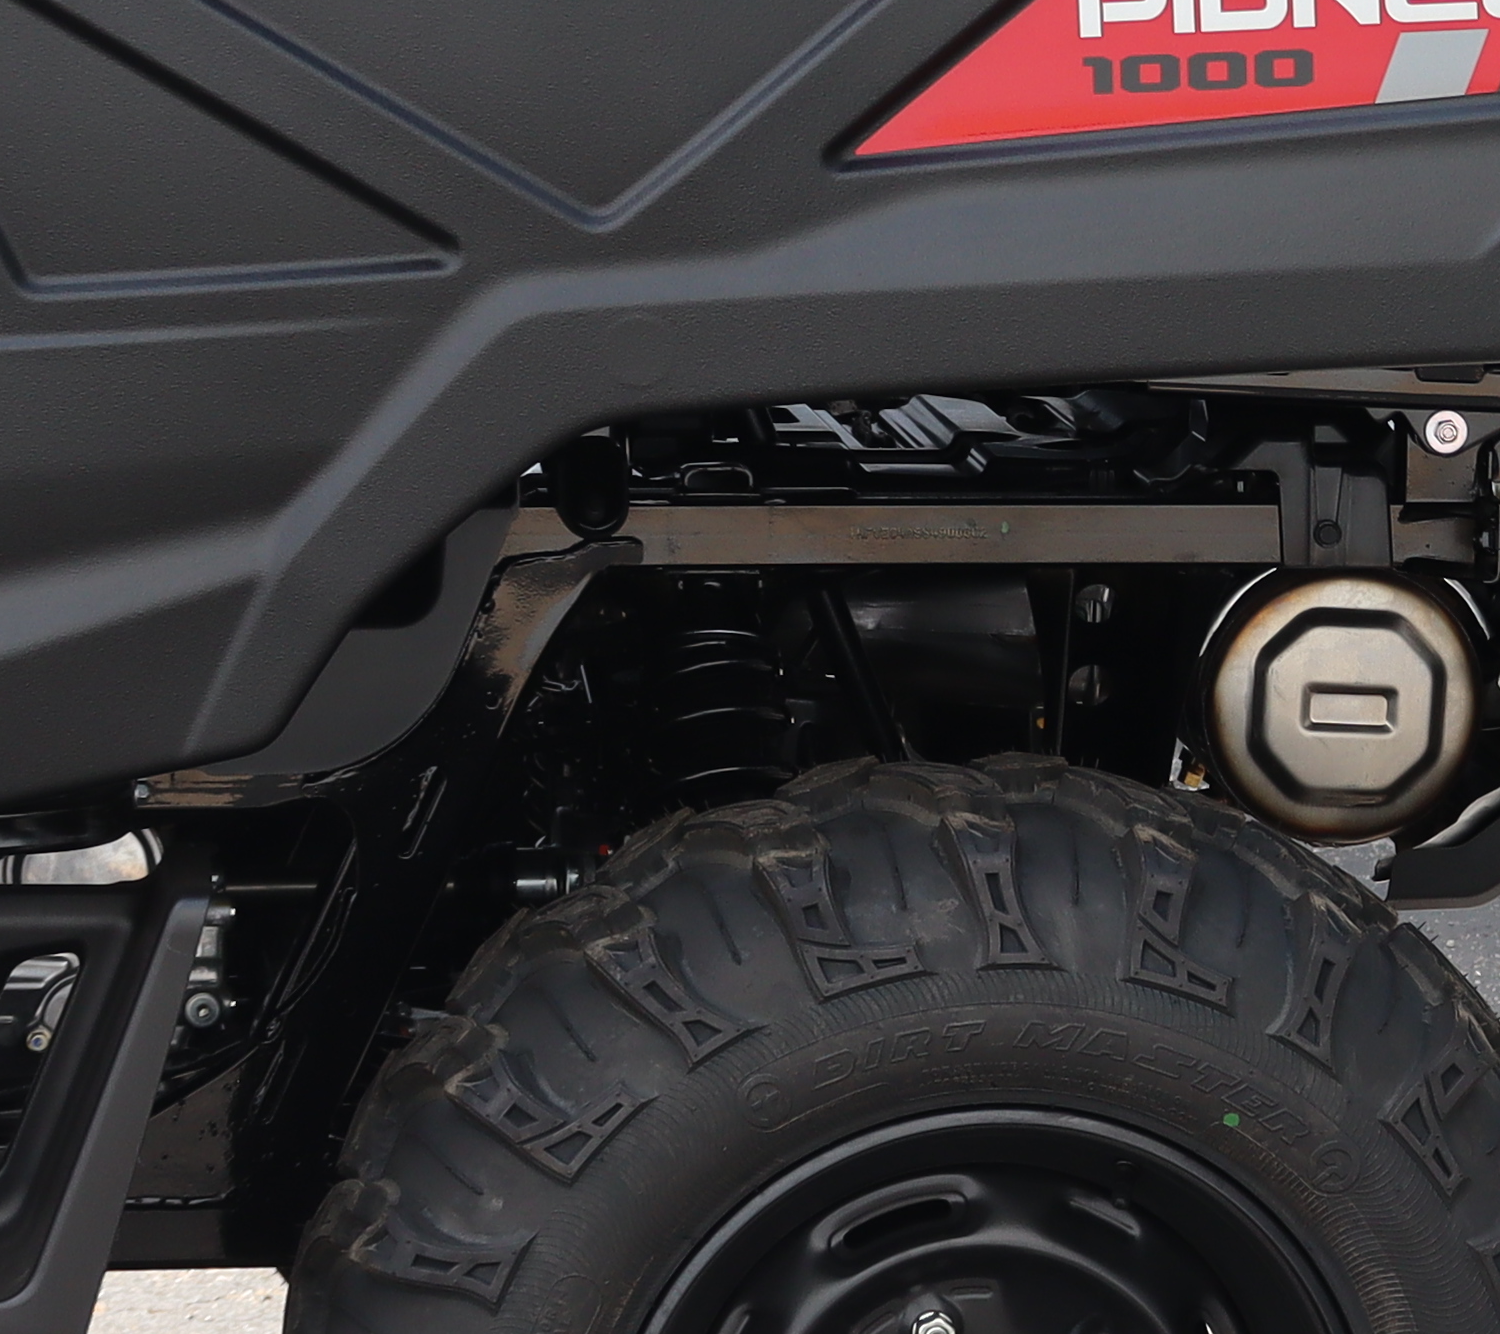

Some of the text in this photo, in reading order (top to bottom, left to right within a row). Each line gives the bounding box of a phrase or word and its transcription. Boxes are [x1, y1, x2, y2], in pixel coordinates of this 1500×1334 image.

[1082, 48, 1315, 95] 1000
[810, 1019, 984, 1089] DIRT
[1015, 1021, 1313, 1147] MASTER
